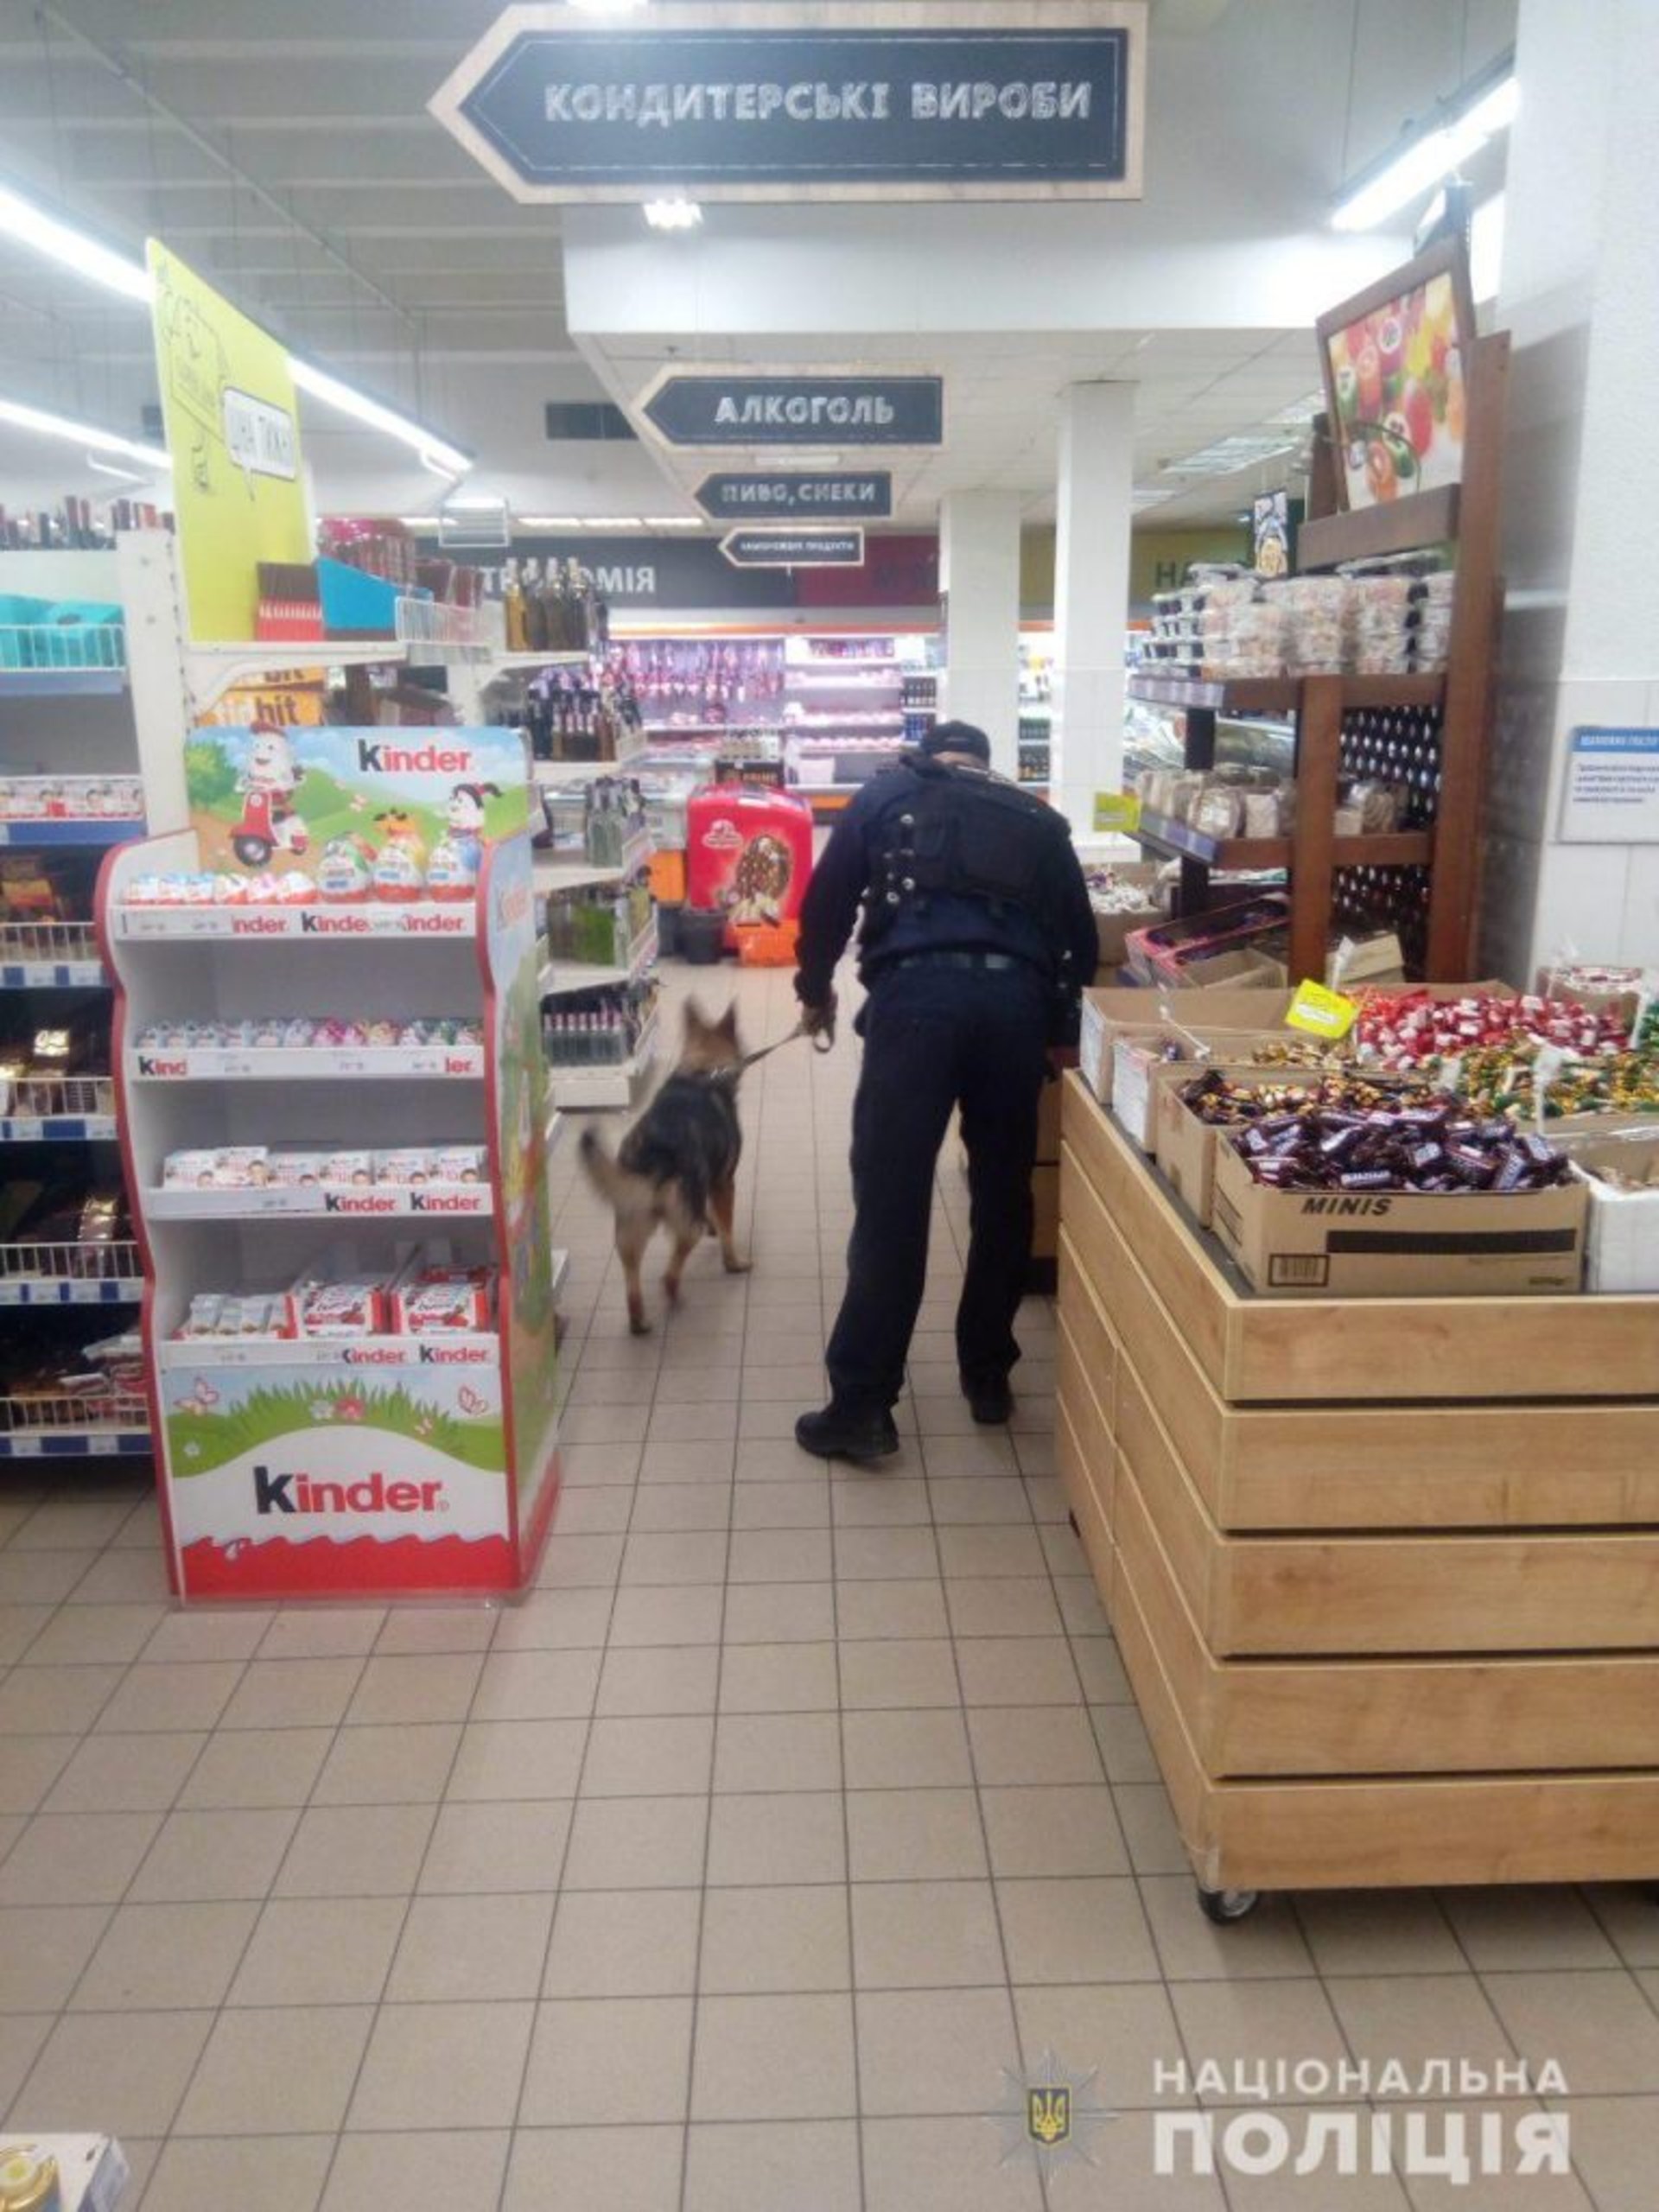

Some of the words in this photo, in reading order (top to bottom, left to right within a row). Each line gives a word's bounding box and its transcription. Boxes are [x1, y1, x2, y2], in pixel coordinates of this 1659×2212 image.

[544, 82, 890, 127] КОНДИТЕРСЬКІ
[910, 81, 1091, 121] ВИРОБИ
[715, 396, 895, 424] АЛКОГОЛЬ
[1300, 1196, 1393, 1217] MINIS
